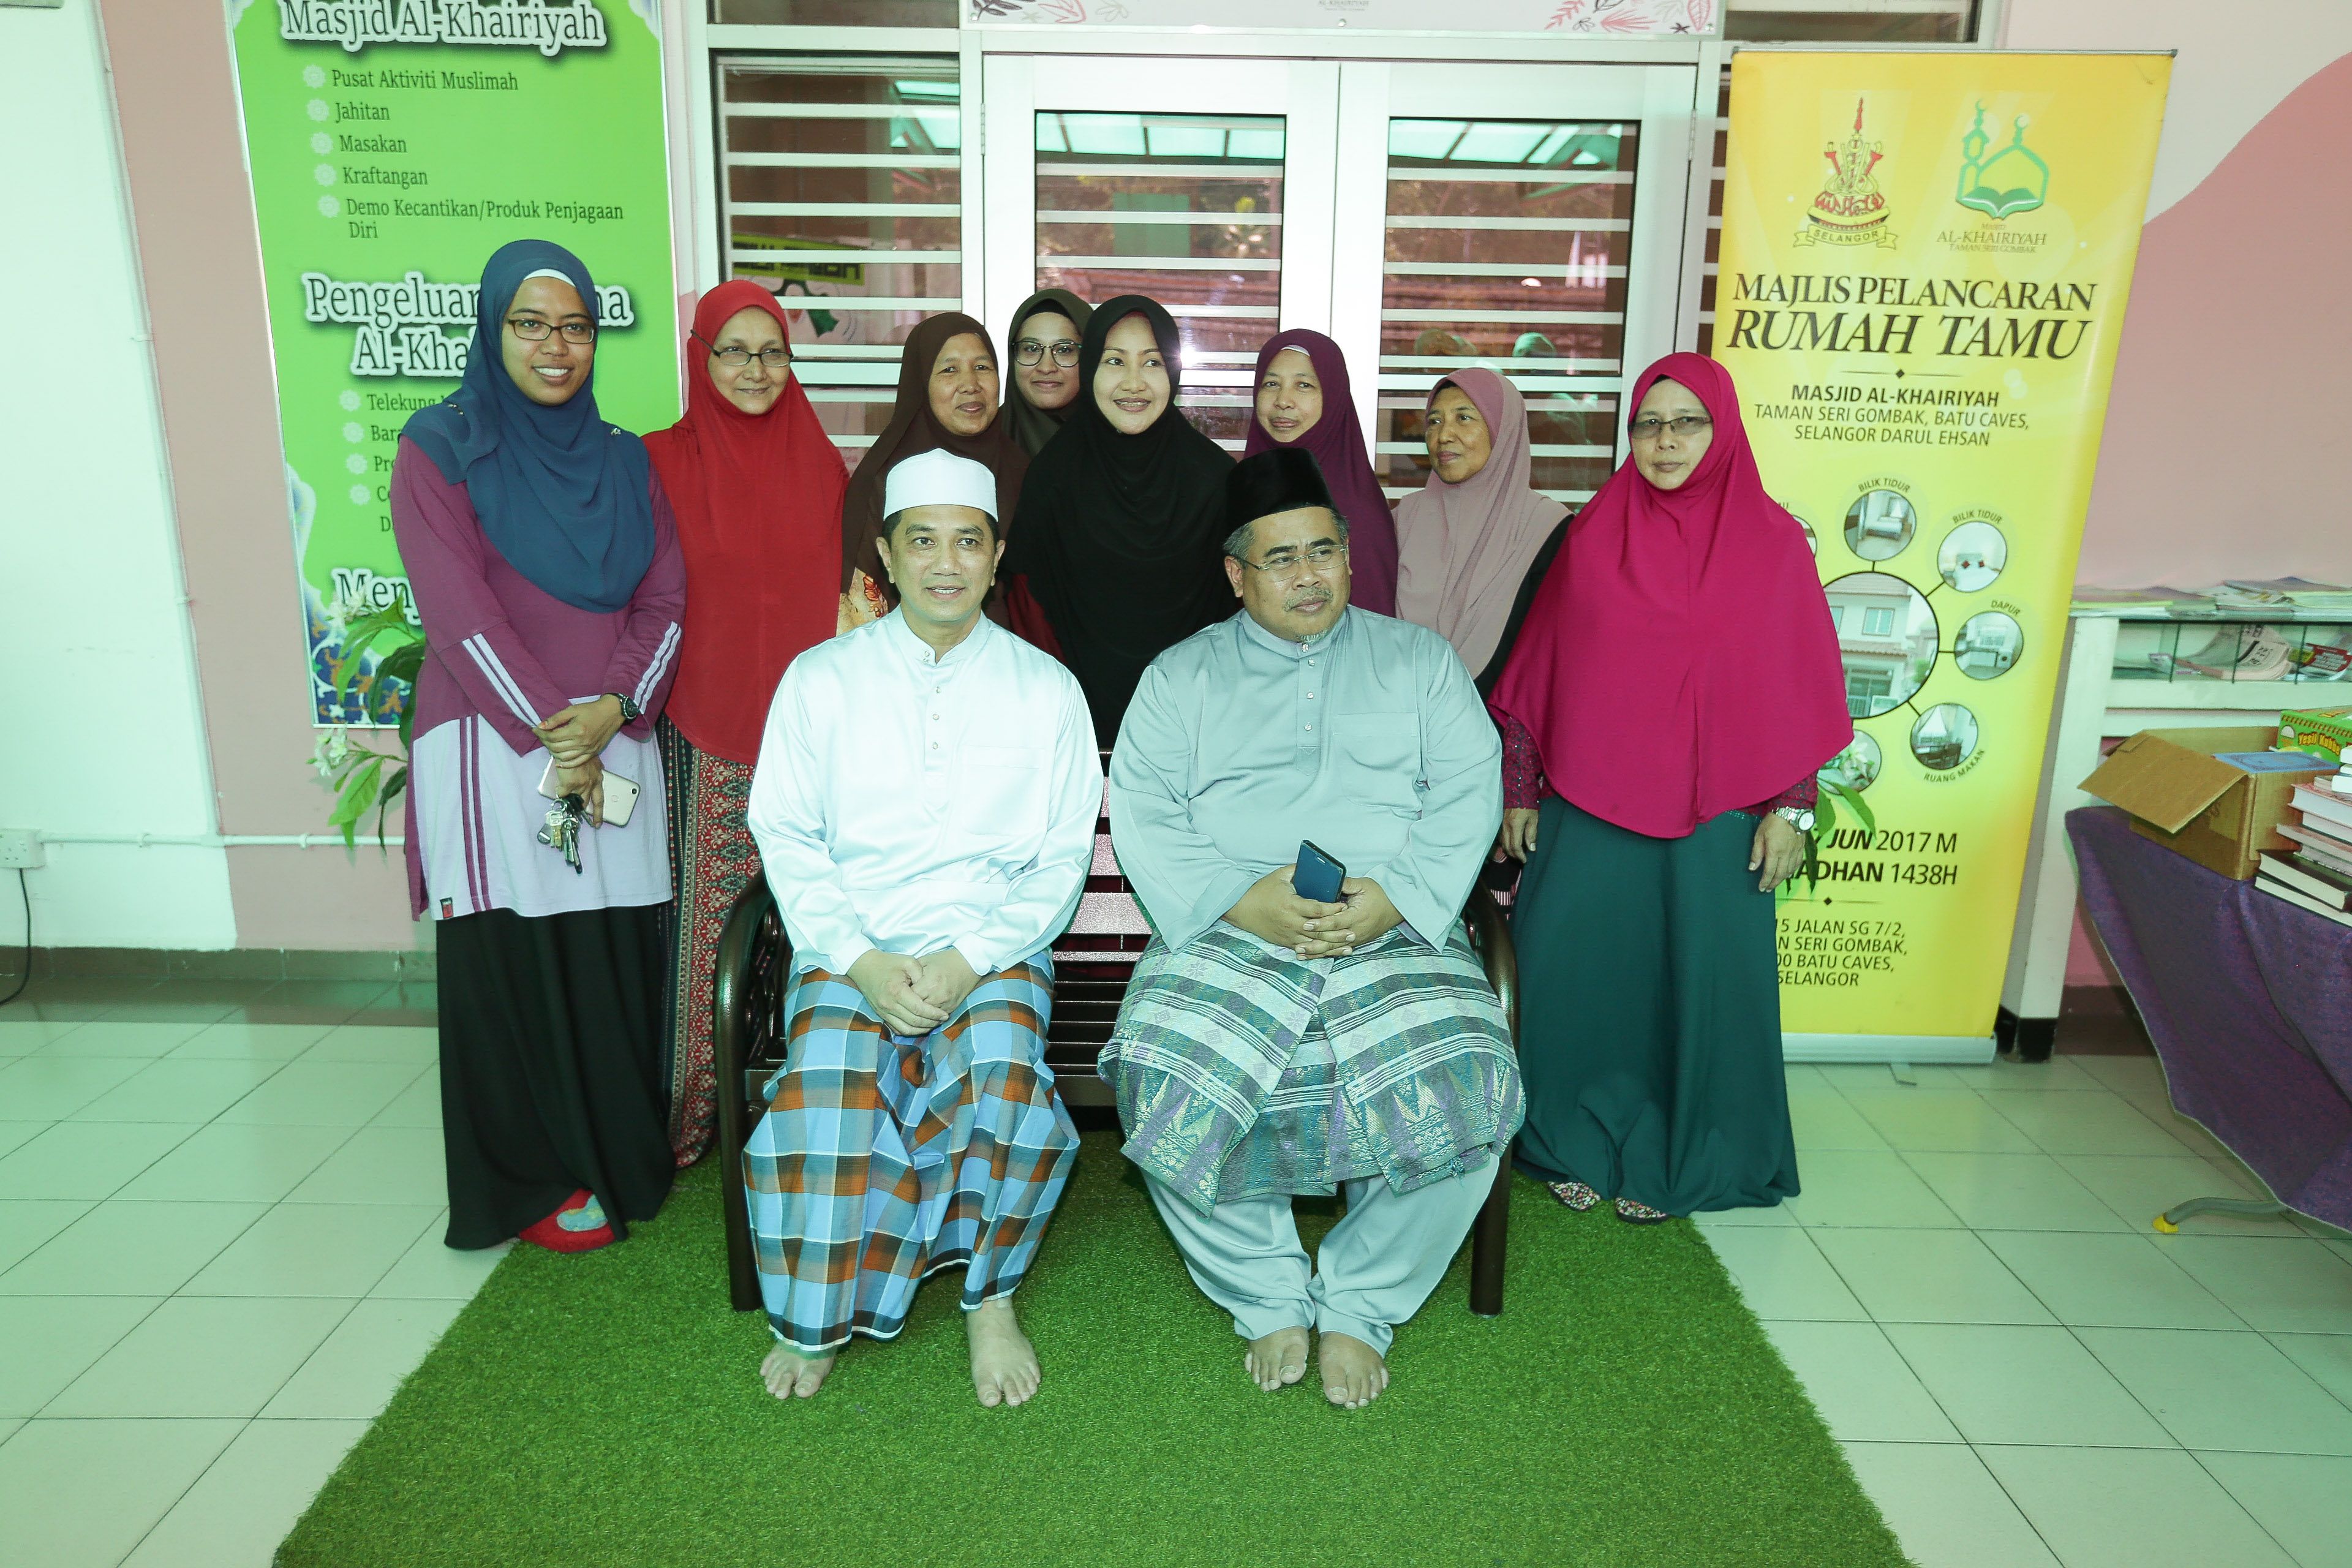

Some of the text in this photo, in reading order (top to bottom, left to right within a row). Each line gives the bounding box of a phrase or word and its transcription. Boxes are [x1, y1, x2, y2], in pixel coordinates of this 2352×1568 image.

[286, 0, 600, 50] Masjid Al-Khairiyah
[332, 69, 519, 90] Pusat Aktiviti Muslimah
[335, 102, 391, 123] Jahitan
[339, 135, 408, 153] Masakan
[342, 167, 429, 190] Kraftangan
[346, 198, 624, 224] Demo Kecantikan/Produk Penjagaan
[349, 221, 379, 239] Diri
[1813, 229, 1880, 242] SELANGOR
[1936, 230, 2047, 245] AL-KHAIRIYAH
[2000, 245, 2037, 254] GOMBAK
[1733, 273, 2098, 311] MAJLIS PELANCARAN
[1726, 309, 2093, 360] RUMAH TAMU
[1792, 385, 1999, 407] MASJID AL-KHAIRIYAH
[1755, 404, 2029, 431] TAMAN SERI GOMBAK, BATU CAVES,
[1795, 425, 1990, 446] SELANGOR DARUL EHSAN
[1858, 478, 1910, 493] BILIK TIDUR
[1952, 510, 2002, 524] BILIK TIDUR
[1991, 600, 2021, 616] DAPUR
[1923, 750, 1985, 782] RUANG MAKAN
[1826, 829, 1872, 850] JUN
[1876, 830, 1931, 852] 2017
[1936, 833, 1958, 853] M
[1787, 860, 1958, 886] ADHAN 1438H
[1794, 919, 1844, 934] JALAN
[1850, 921, 1869, 935] SG
[1875, 921, 1905, 939] 7/2,
[1795, 937, 1827, 951] SERI
[1833, 938, 1907, 956] GOMBAK,
[1797, 954, 1837, 968] BATU
[1842, 956, 1894, 973] CAVES,
[1778, 971, 1859, 986] SELANGOR
